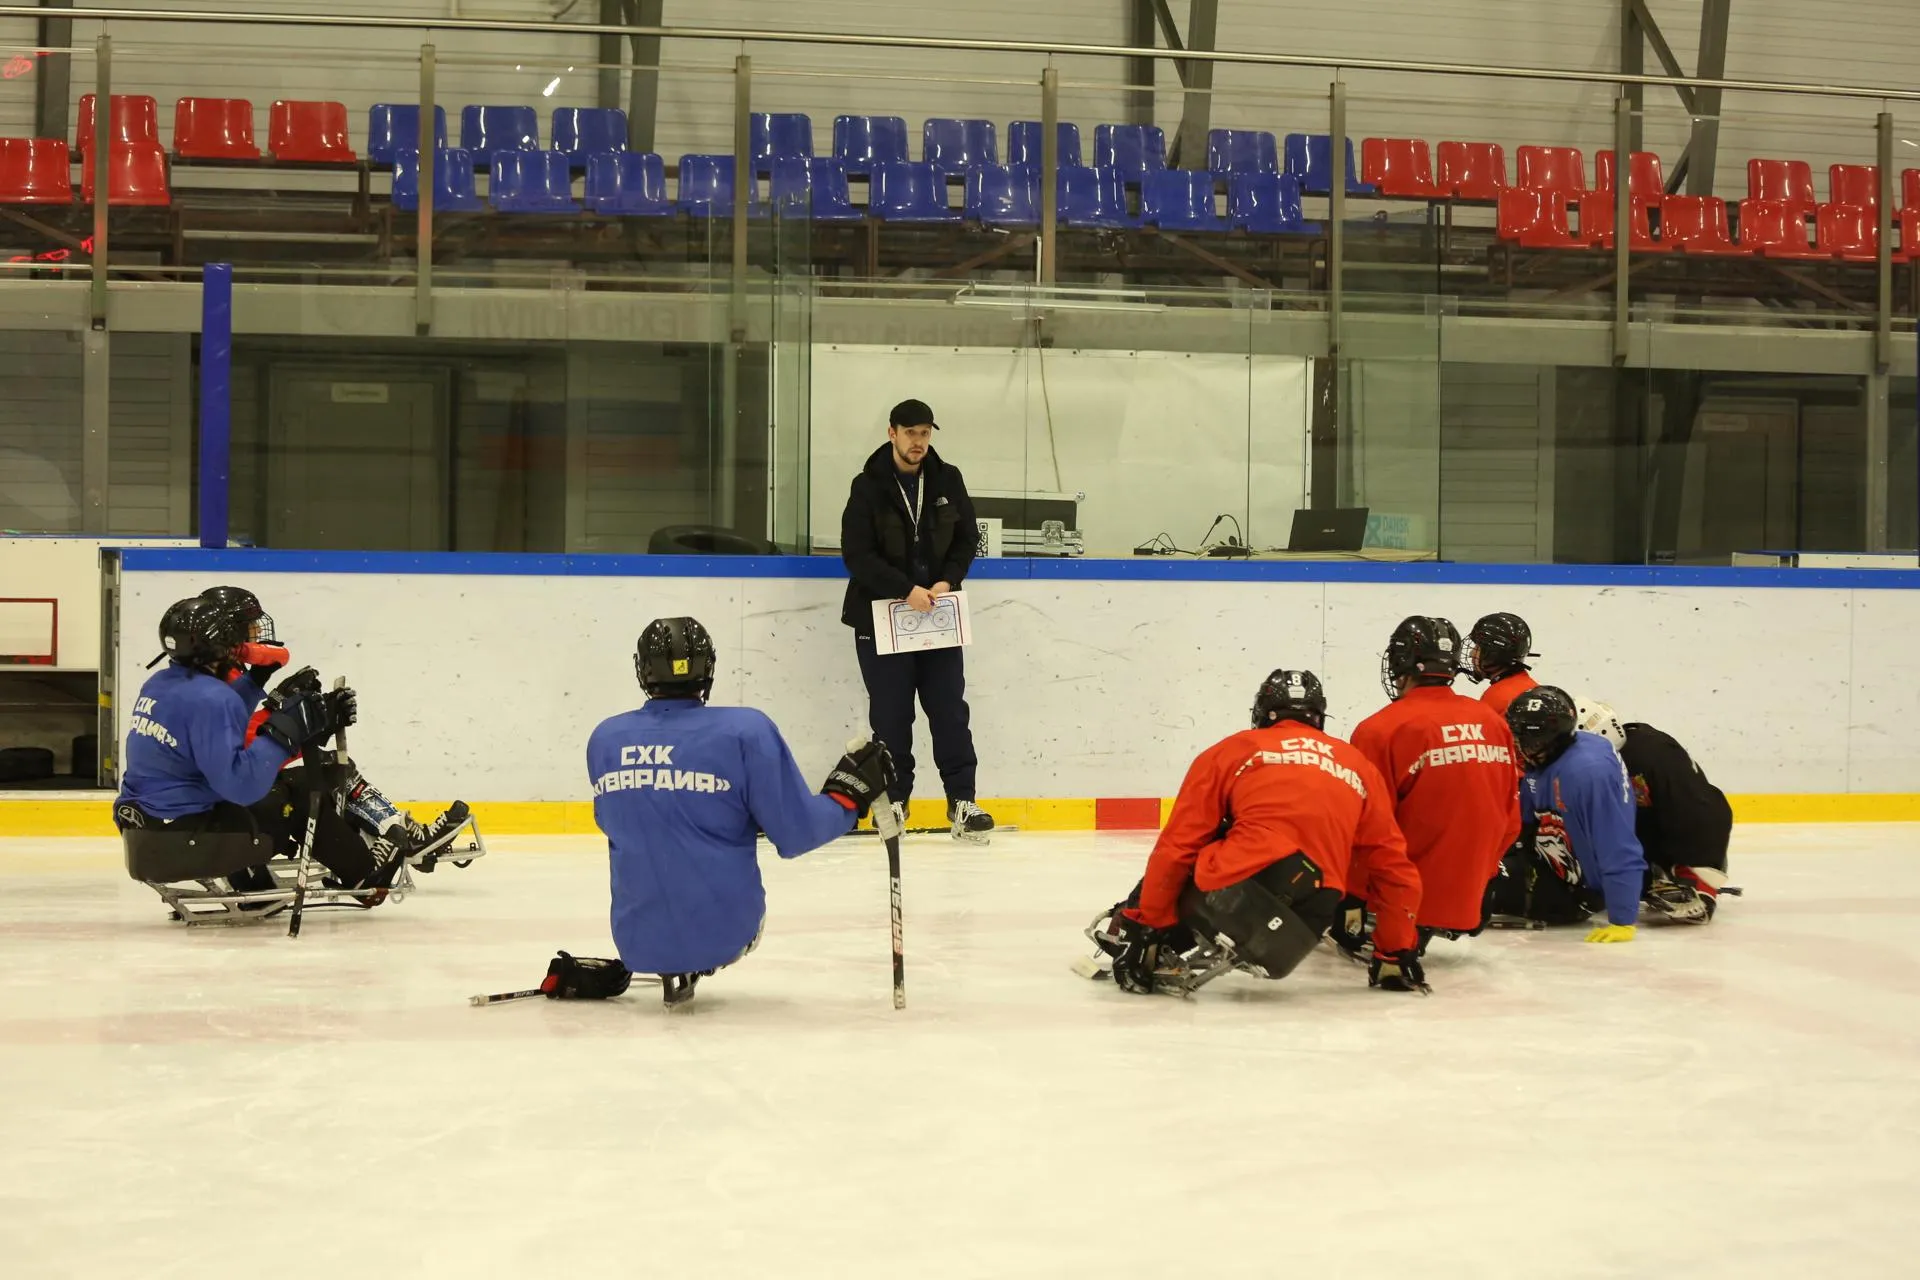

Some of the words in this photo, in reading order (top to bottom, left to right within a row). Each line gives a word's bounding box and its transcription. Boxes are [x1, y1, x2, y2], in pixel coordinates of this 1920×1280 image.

[1291, 673, 1302, 686] 8
[1527, 699, 1543, 711] 13
[1441, 724, 1486, 743] СХК
[621, 745, 674, 766] СХК
[1280, 737, 1334, 759] СХК
[1267, 916, 1283, 931] 8
